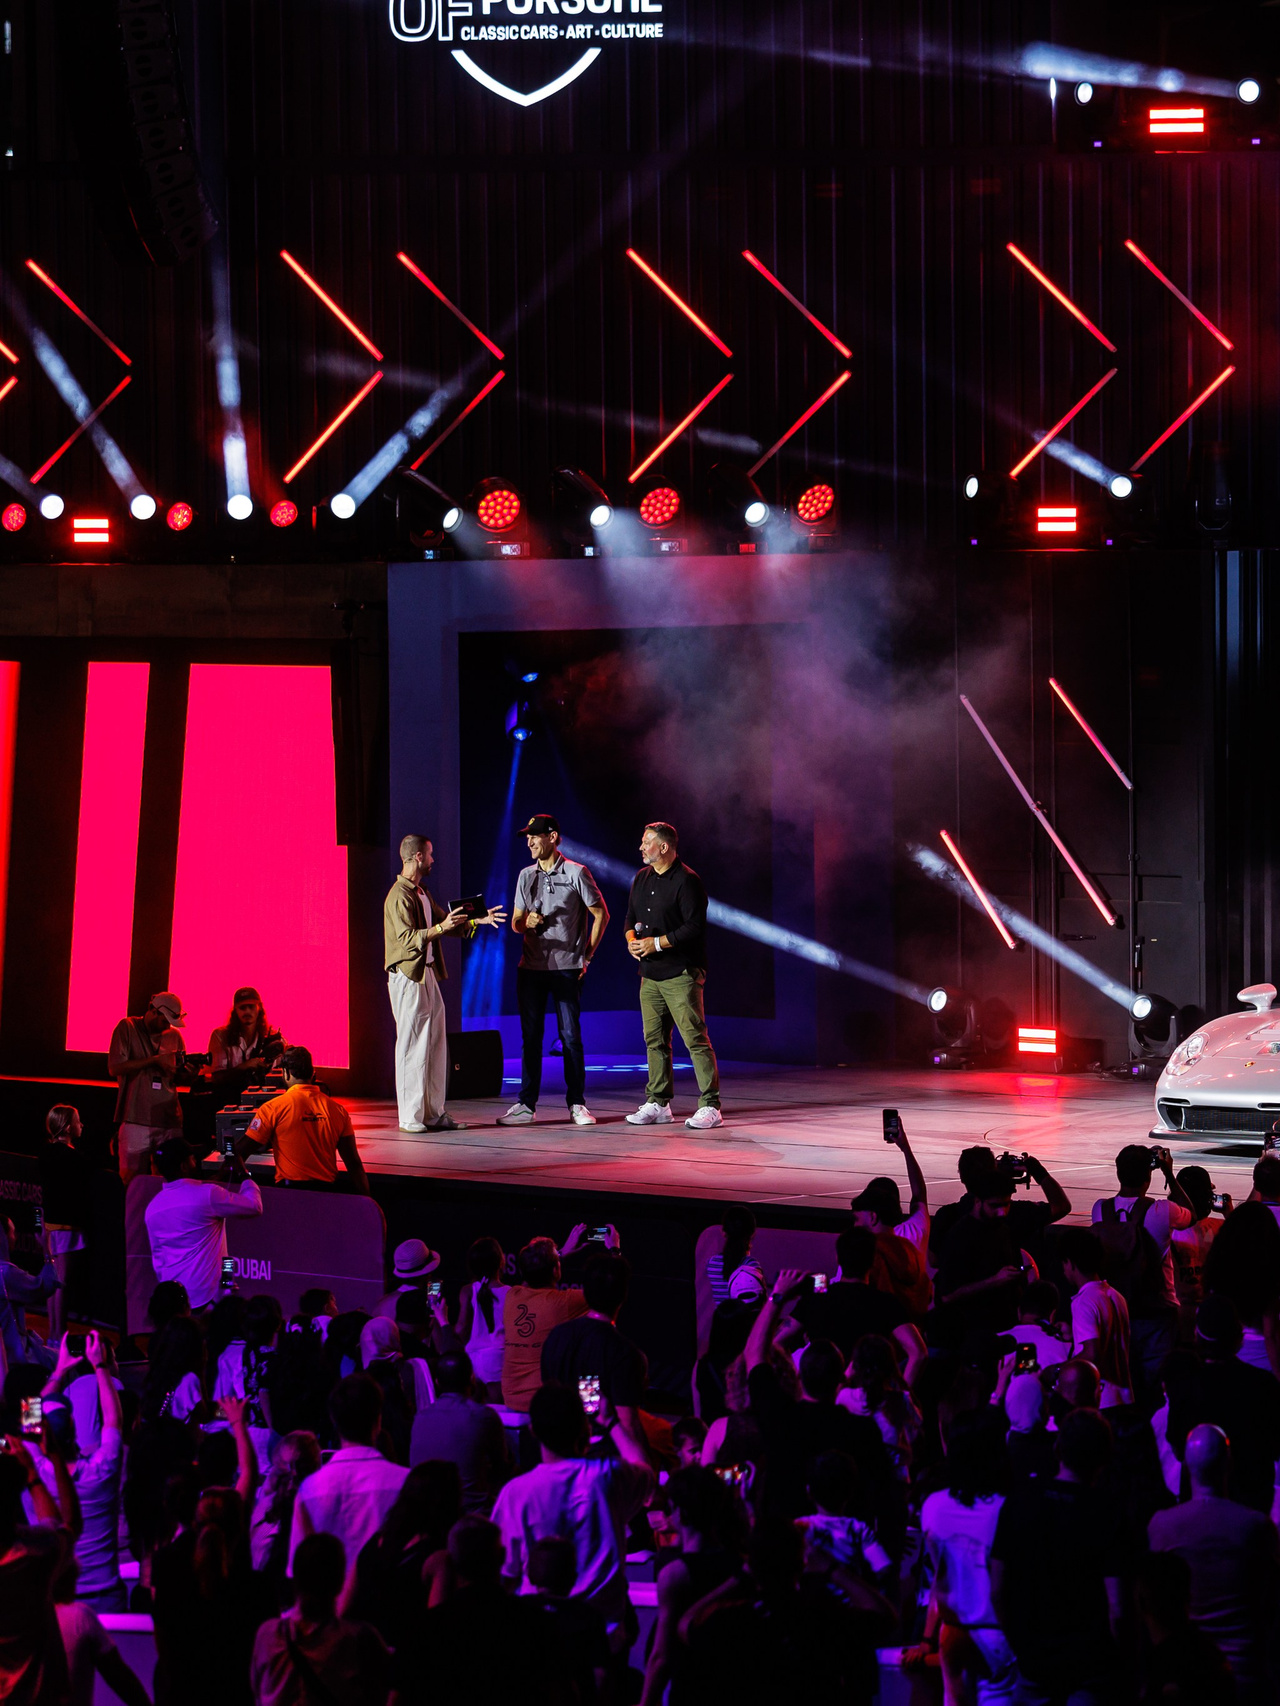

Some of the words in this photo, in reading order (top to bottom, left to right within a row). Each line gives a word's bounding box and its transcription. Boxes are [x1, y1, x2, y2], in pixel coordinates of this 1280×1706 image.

[461, 25, 520, 41] CLASSIC
[520, 24, 559, 40] CARS
[565, 24, 594, 39] ART
[601, 23, 664, 39] CULTURE
